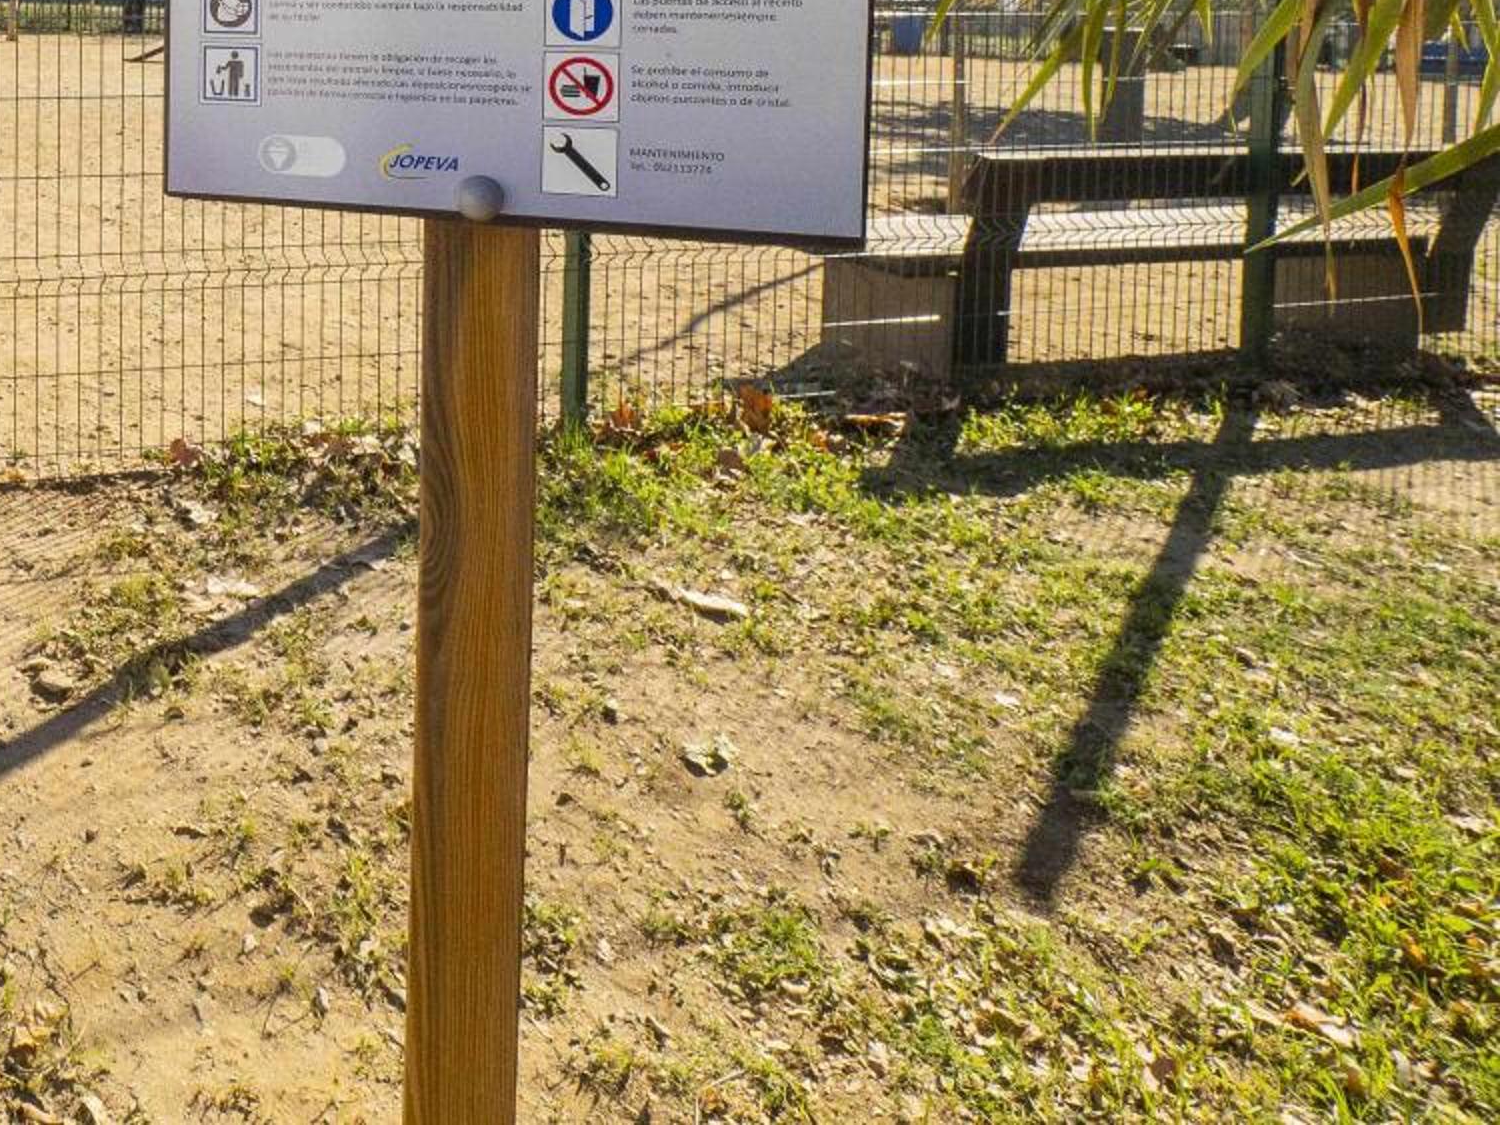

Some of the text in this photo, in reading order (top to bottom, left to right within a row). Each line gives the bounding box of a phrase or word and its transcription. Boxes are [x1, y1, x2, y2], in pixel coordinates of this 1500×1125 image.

[630, 65, 643, 74] Se
[702, 69, 753, 78] consumo
[755, 69, 769, 78] de
[631, 79, 669, 90] alcohol
[739, 96, 752, 106] de
[629, 148, 725, 162] MANTENIMIENTO
[389, 155, 459, 172] JOPEVA
